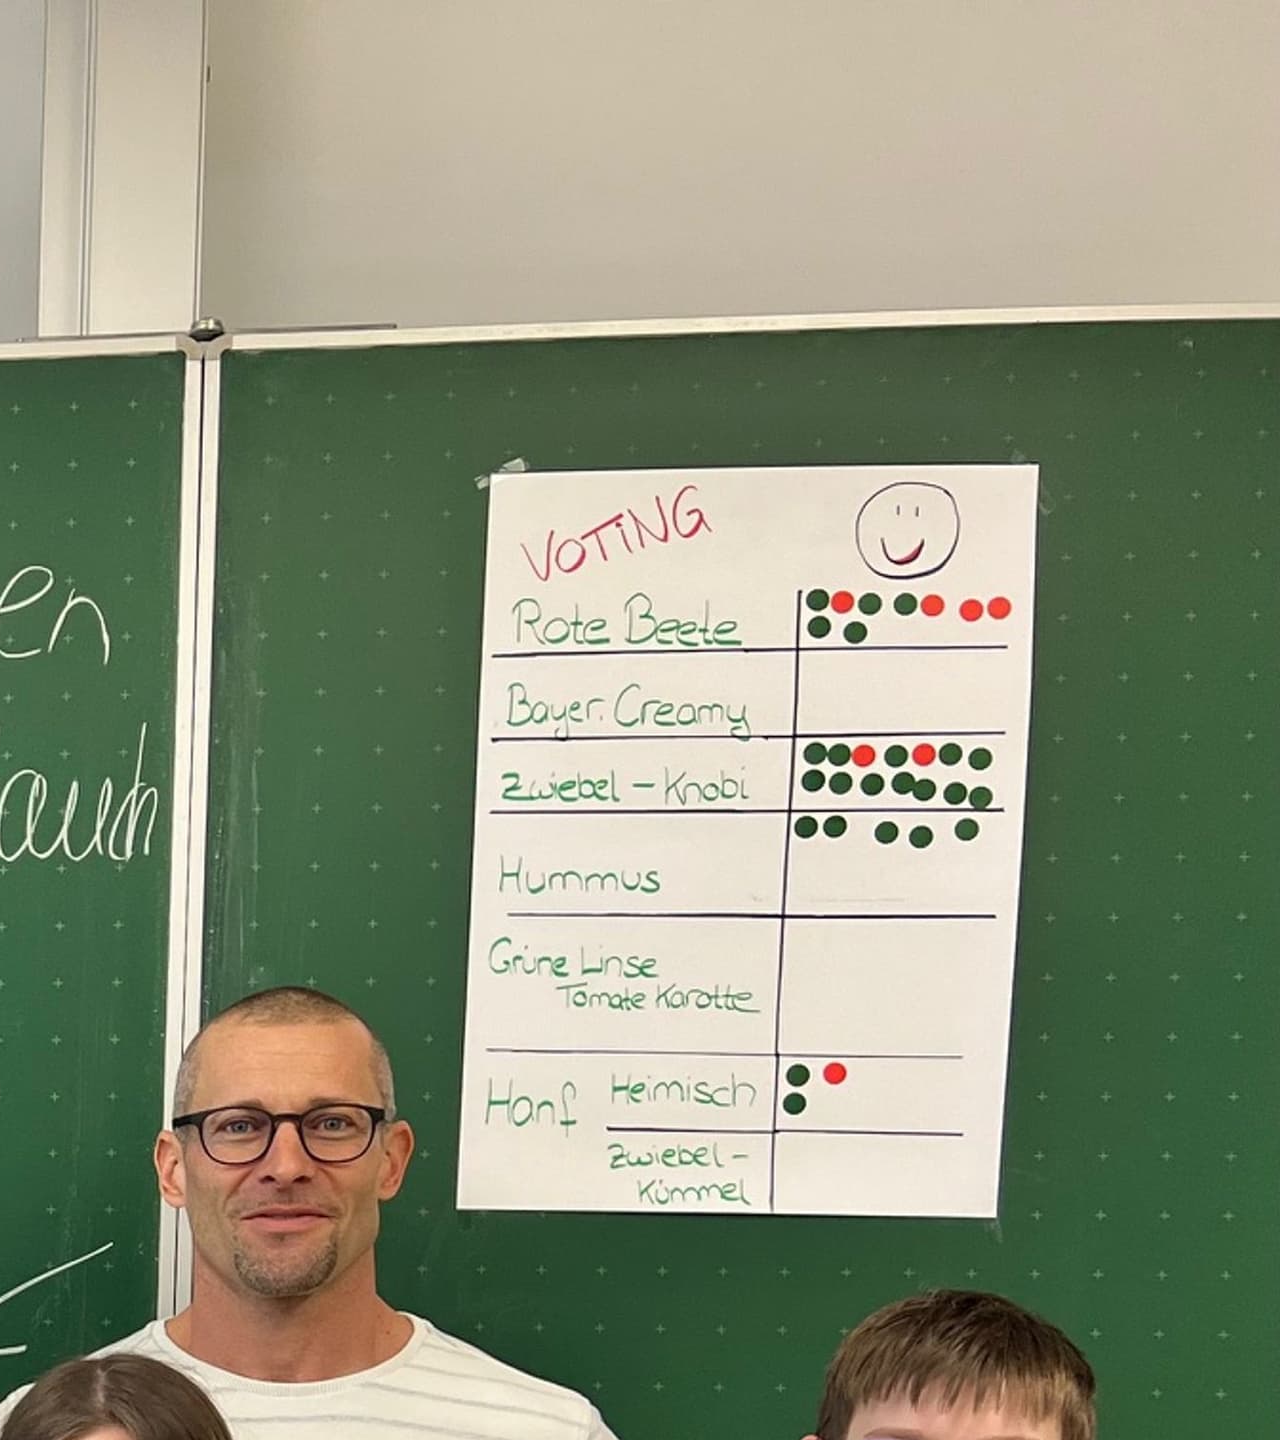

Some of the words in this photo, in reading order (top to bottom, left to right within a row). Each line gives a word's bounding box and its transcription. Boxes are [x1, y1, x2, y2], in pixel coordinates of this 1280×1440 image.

[521, 485, 713, 582] VOTING
[513, 597, 610, 646] Rote
[624, 592, 742, 647] Beete
[614, 683, 752, 741] Creamy
[501, 769, 620, 802] Zwiebel
[665, 766, 749, 805] Knobi
[499, 855, 661, 895] Hummus
[580, 945, 658, 978] Linse
[556, 982, 646, 1011] Tomate
[655, 983, 761, 1013] Karotte
[485, 1077, 577, 1138] Hanf
[611, 1072, 757, 1107] Heimisch
[637, 1178, 751, 1206] Kümmel
